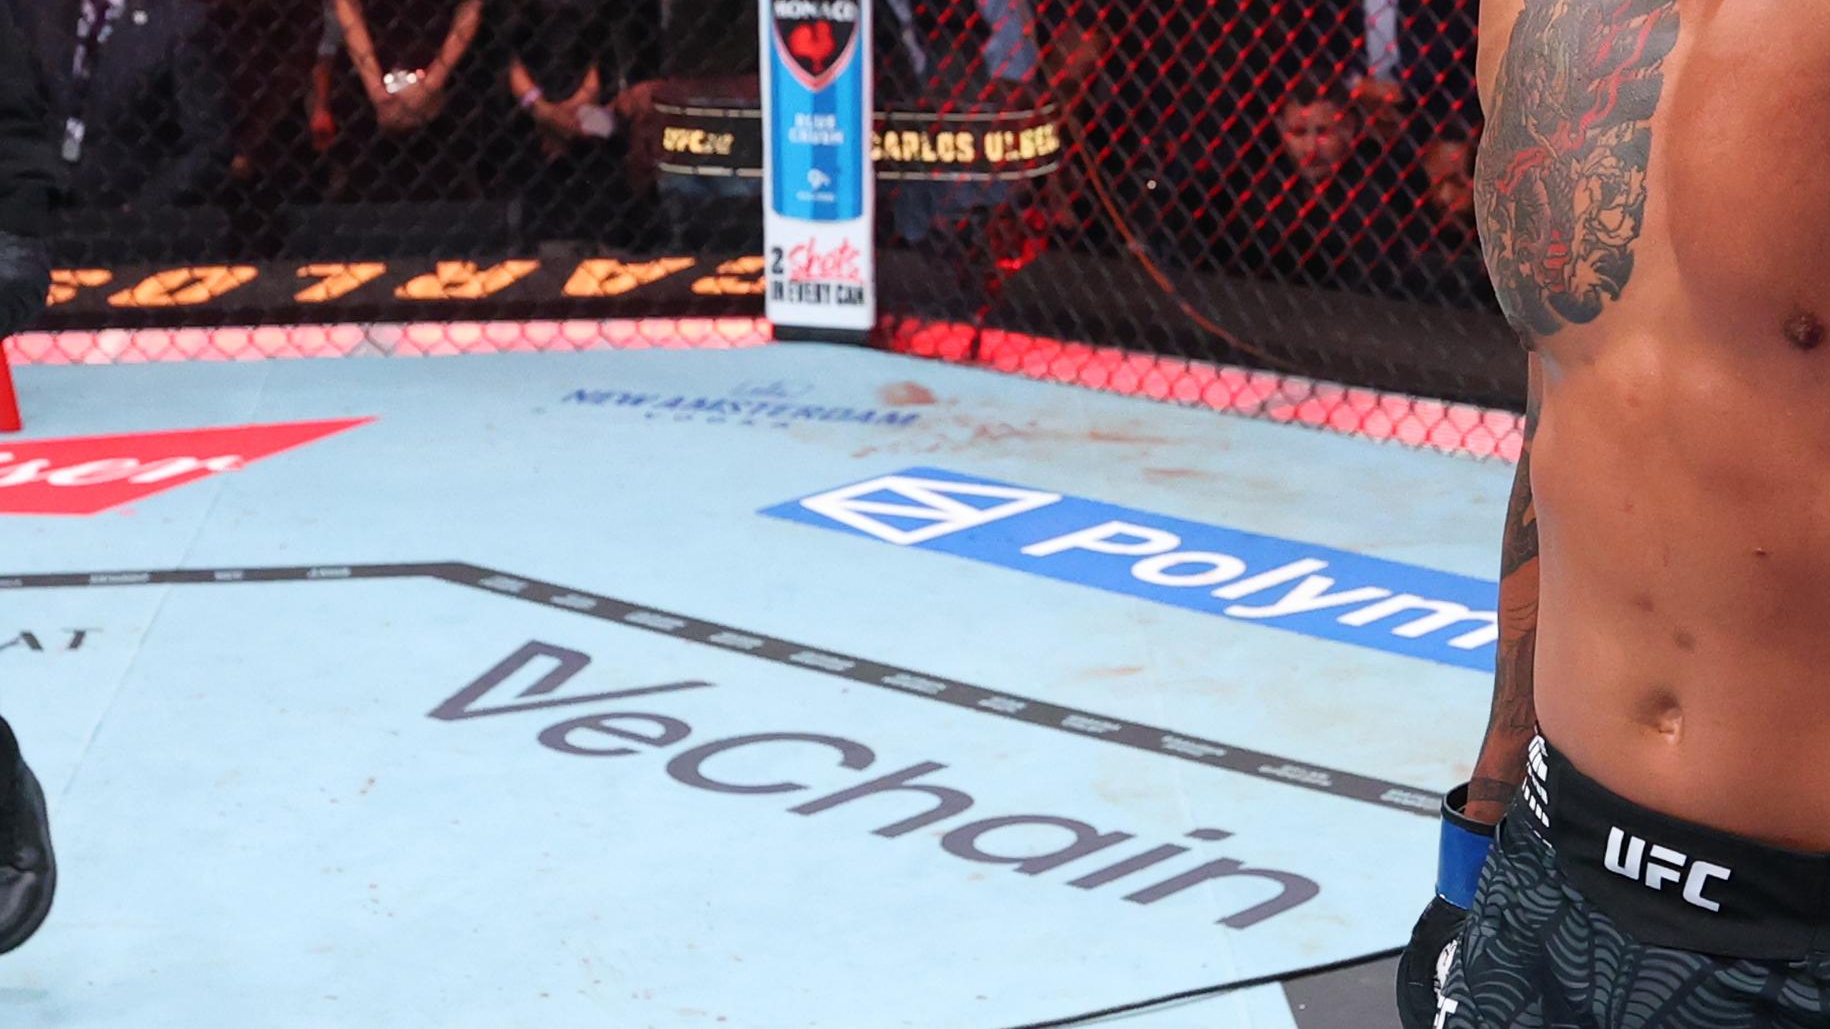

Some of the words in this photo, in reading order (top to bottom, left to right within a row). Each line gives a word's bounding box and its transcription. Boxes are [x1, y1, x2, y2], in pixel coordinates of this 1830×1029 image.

[771, 246, 784, 275] 2
[427, 639, 1321, 930] VeChain
[1603, 825, 1732, 913] UFC
